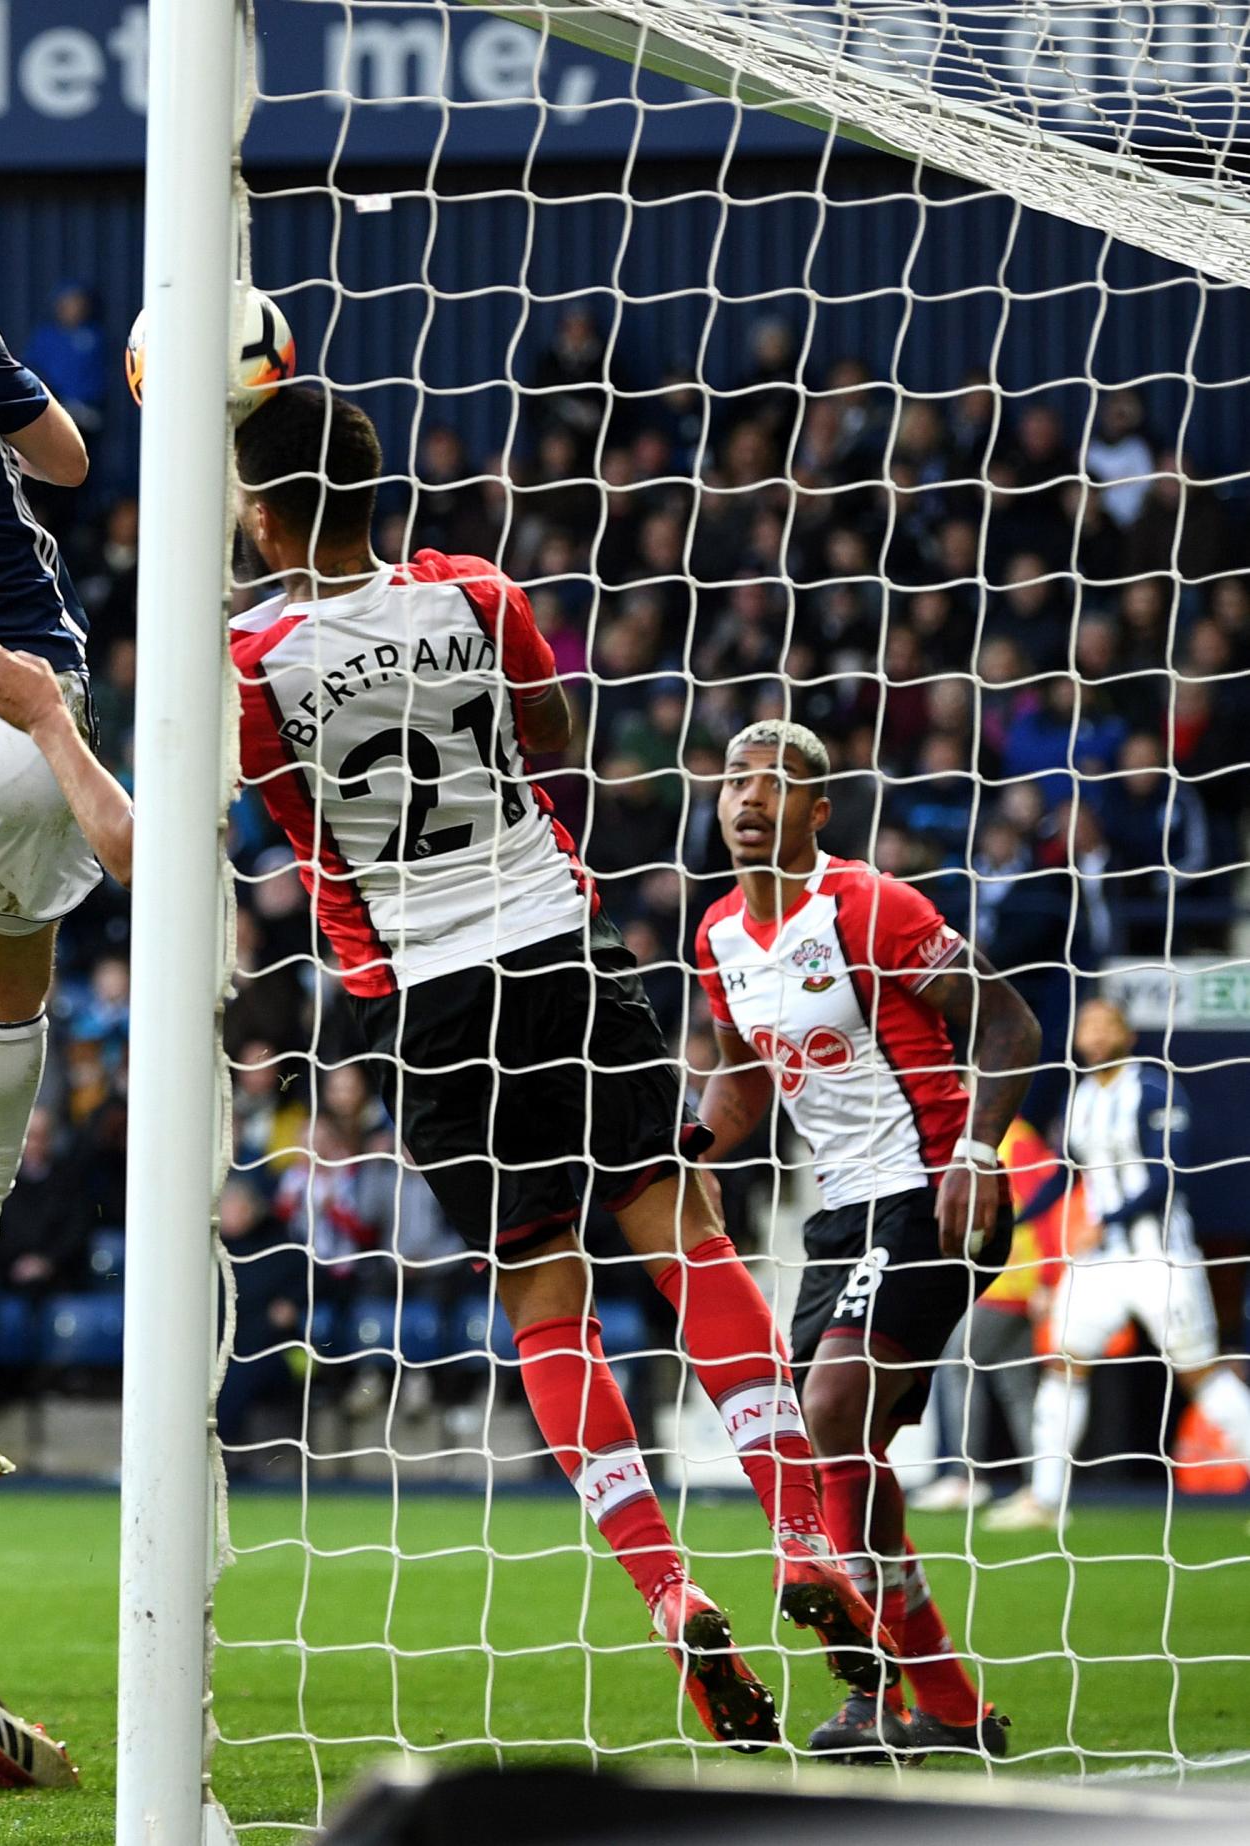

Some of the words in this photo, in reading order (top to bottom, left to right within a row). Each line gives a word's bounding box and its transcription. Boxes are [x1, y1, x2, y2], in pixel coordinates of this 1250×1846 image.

[323, 14, 600, 126] me,
[278, 635, 498, 748] BERTRAND
[338, 690, 526, 862] 21
